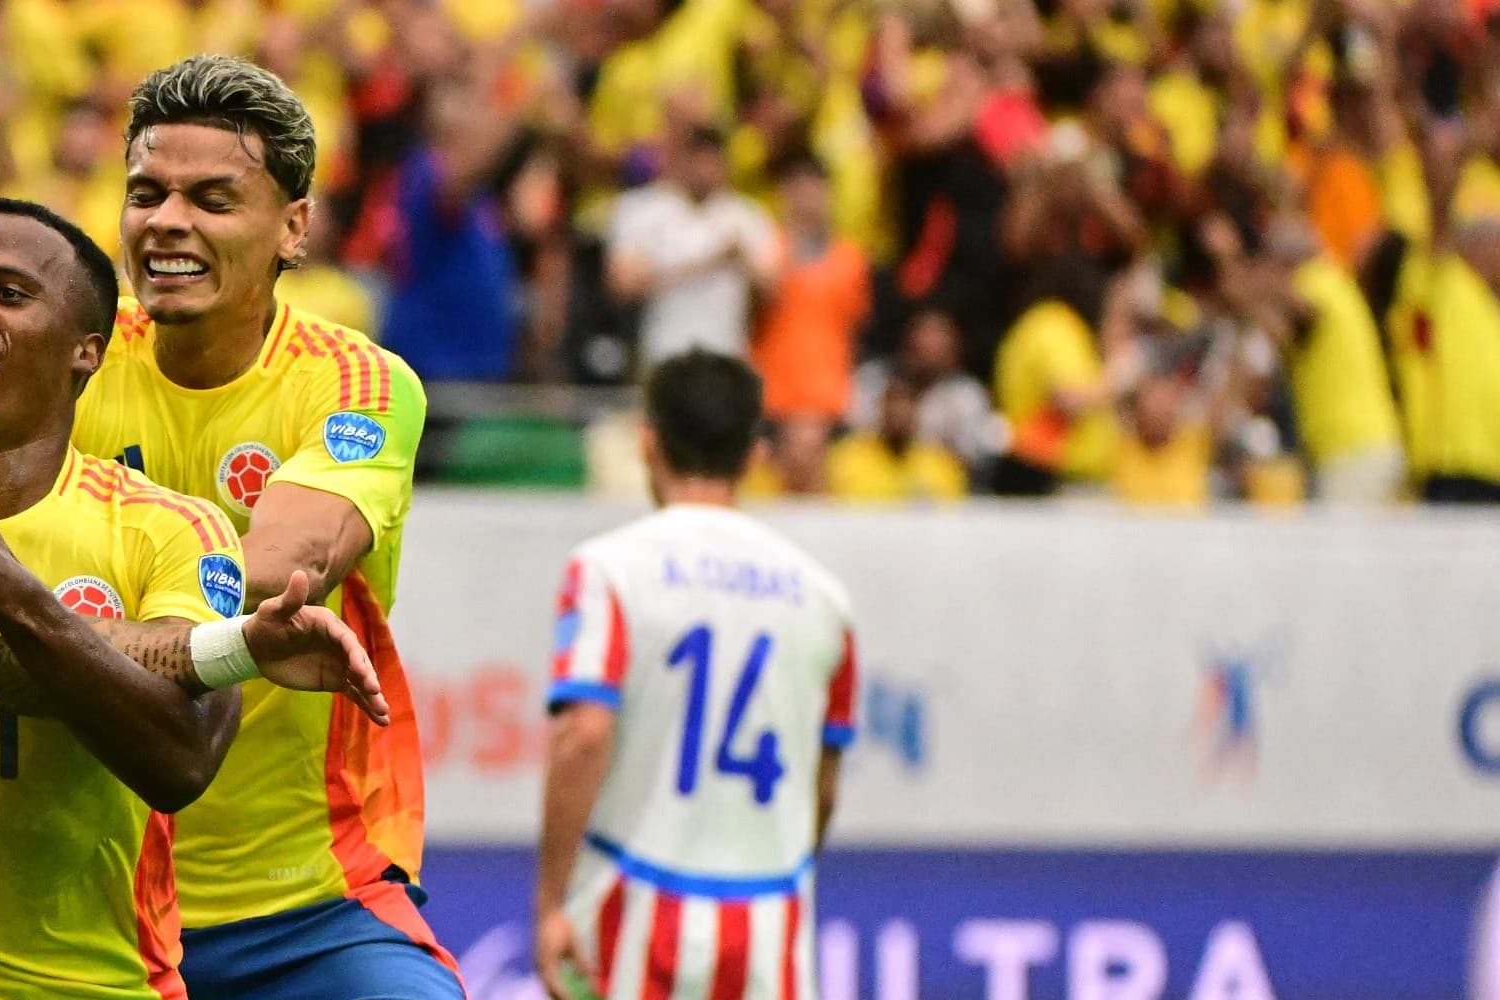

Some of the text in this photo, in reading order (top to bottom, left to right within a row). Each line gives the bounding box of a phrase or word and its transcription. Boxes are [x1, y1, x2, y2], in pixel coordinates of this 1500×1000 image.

[330, 424, 377, 444] VIBRA
[206, 570, 241, 593] VIBRA
[667, 624, 786, 805] 14
